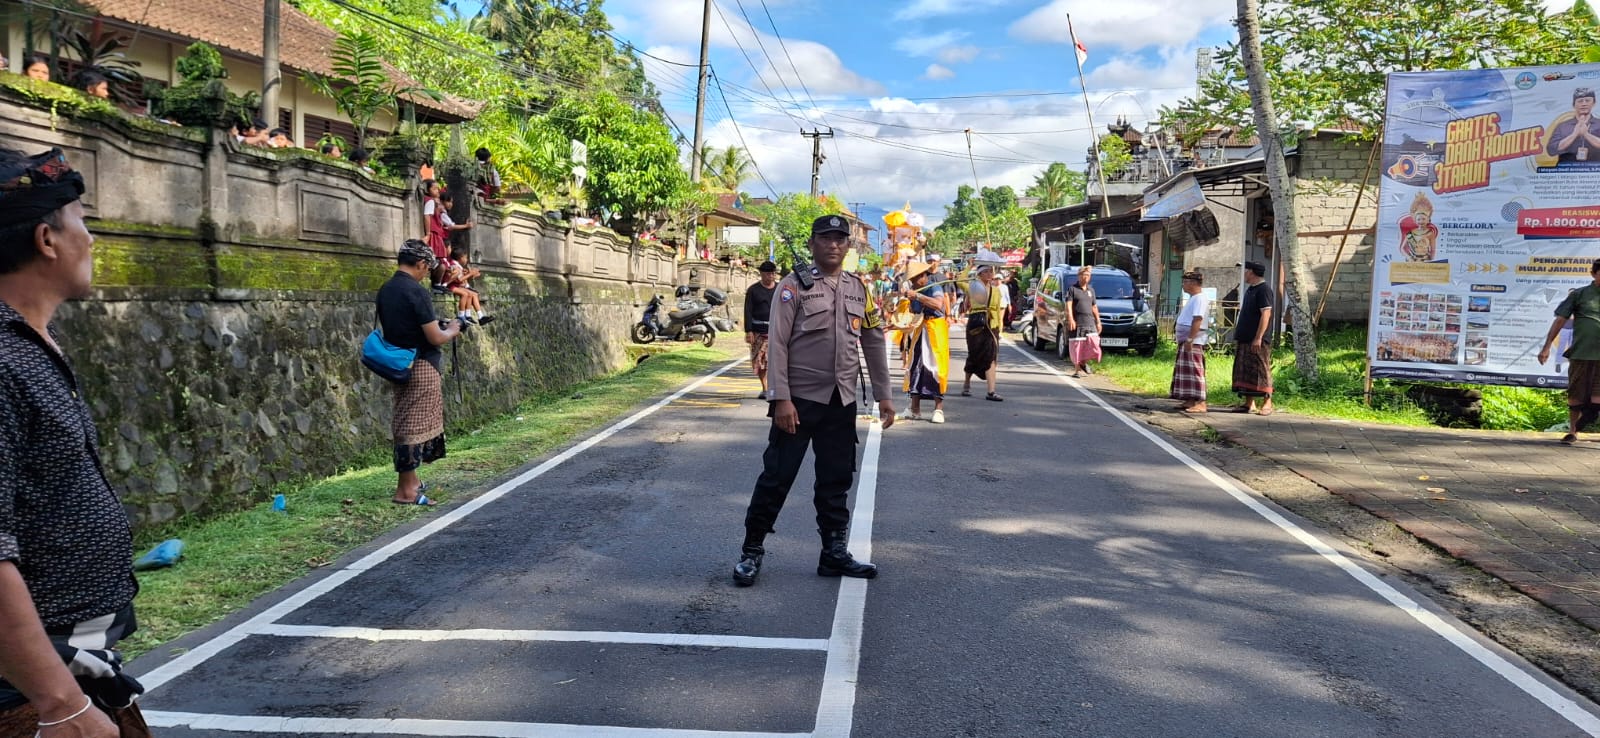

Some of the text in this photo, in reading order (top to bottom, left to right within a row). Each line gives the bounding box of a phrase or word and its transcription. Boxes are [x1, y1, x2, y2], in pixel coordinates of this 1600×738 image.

[1447, 112, 1498, 143] GRATIS
[1445, 138, 1482, 166] DANA
[1524, 217, 1543, 228] Rp.
[844, 294, 865, 303] POLRI
